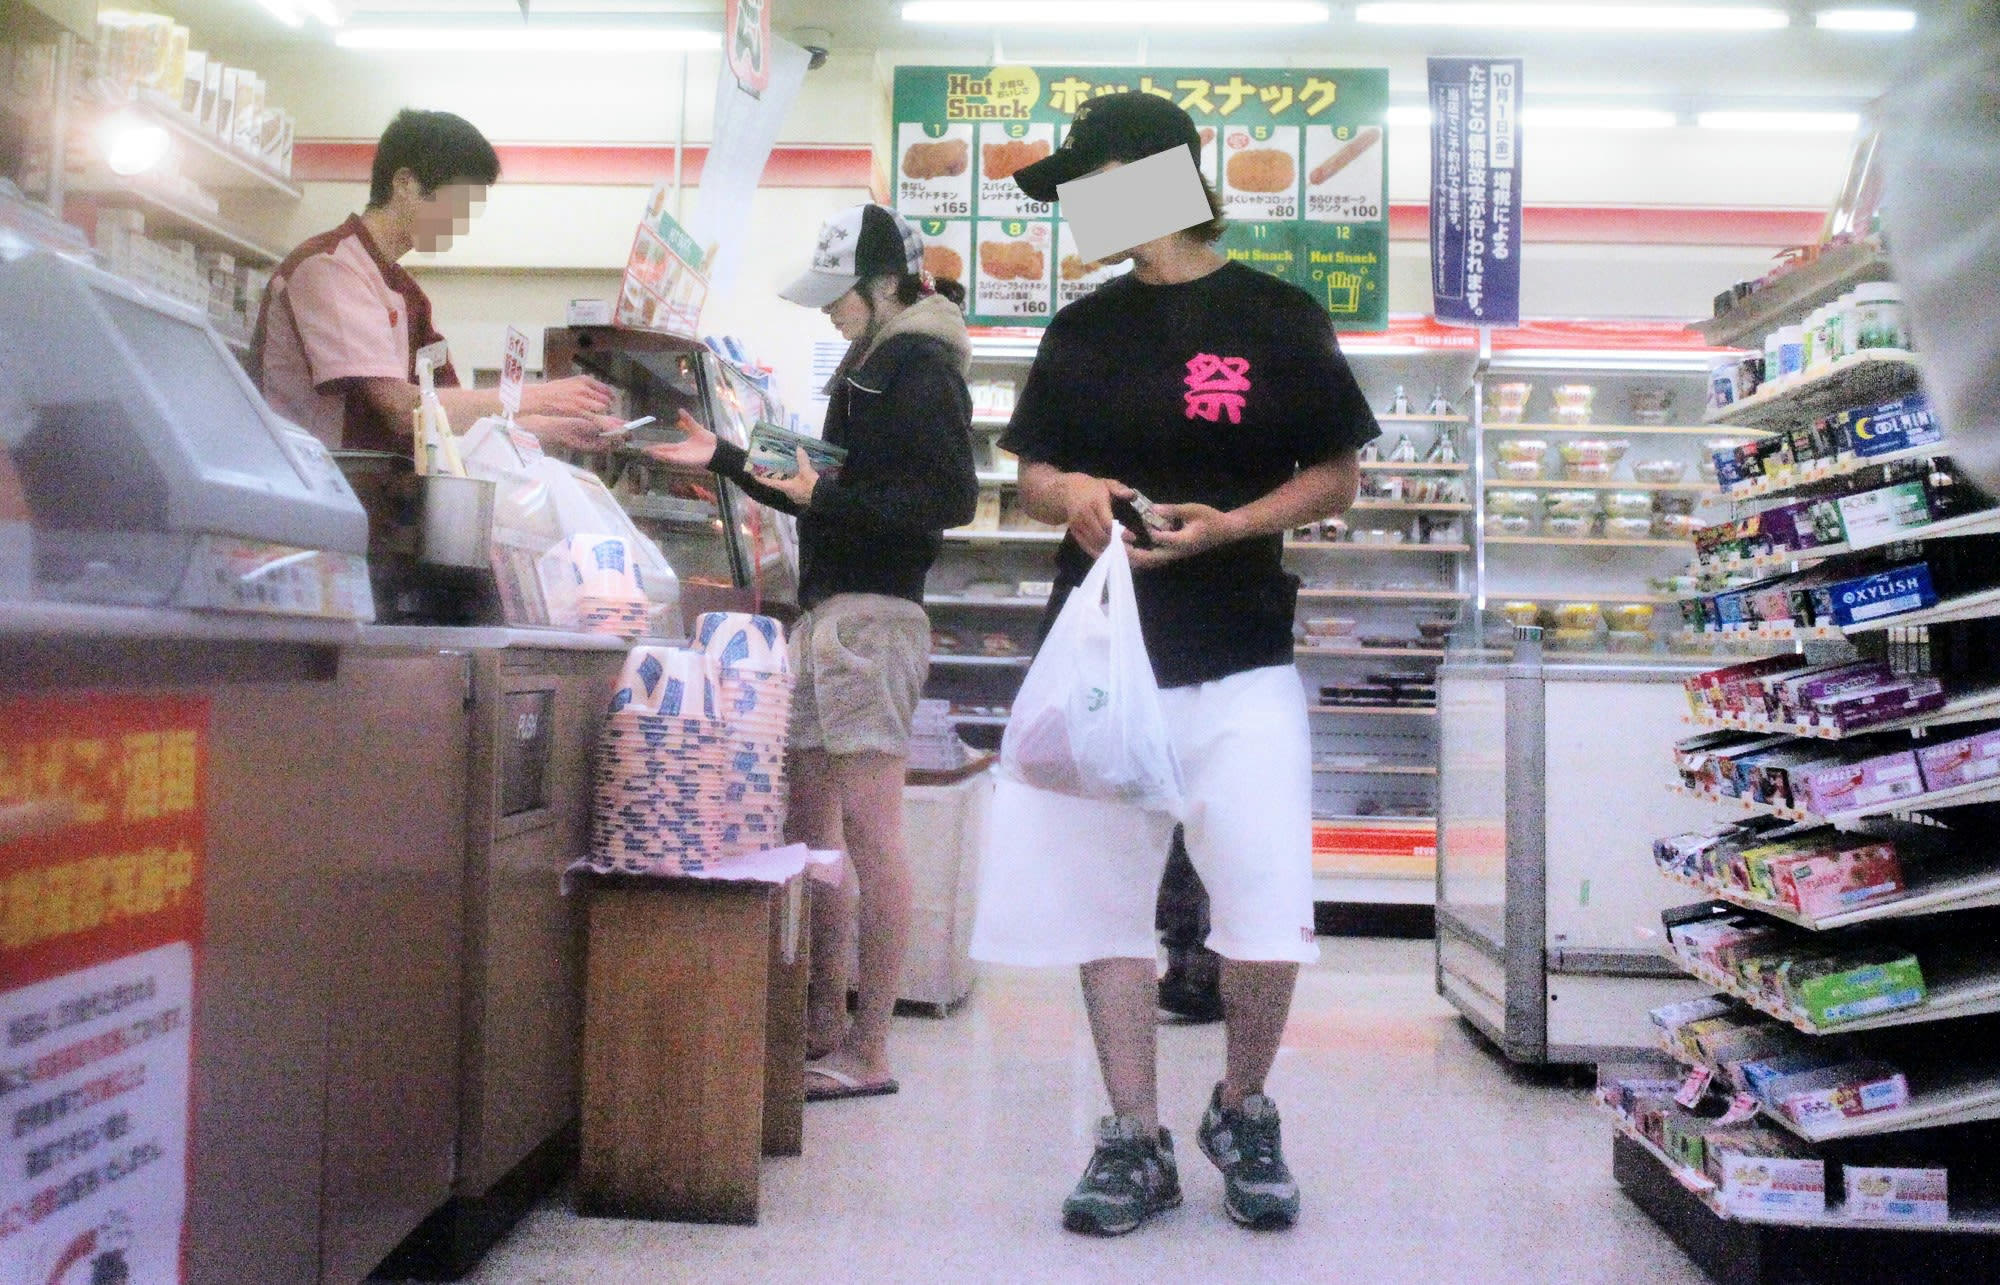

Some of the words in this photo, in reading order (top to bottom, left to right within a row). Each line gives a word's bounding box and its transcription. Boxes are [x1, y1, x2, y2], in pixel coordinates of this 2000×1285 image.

[948, 75, 993, 97] Hot
[948, 98, 1029, 119] Snack
[933, 123, 941, 136] 1
[1011, 124, 1025, 137] 2
[1255, 125, 1268, 139] 5
[1336, 126, 1349, 140] 6
[934, 202, 968, 214] ¥165
[1016, 201, 1050, 214] ¥160
[1268, 205, 1295, 217] ¥80
[1343, 205, 1378, 217] ¥100
[1491, 170, 1512, 260] 増税による
[928, 221, 941, 234] 7
[1008, 221, 1022, 236] 8
[1254, 225, 1267, 238] 11
[1335, 225, 1351, 239] 12
[1013, 301, 1047, 313] ¥160
[1184, 352, 1251, 424] 祭
